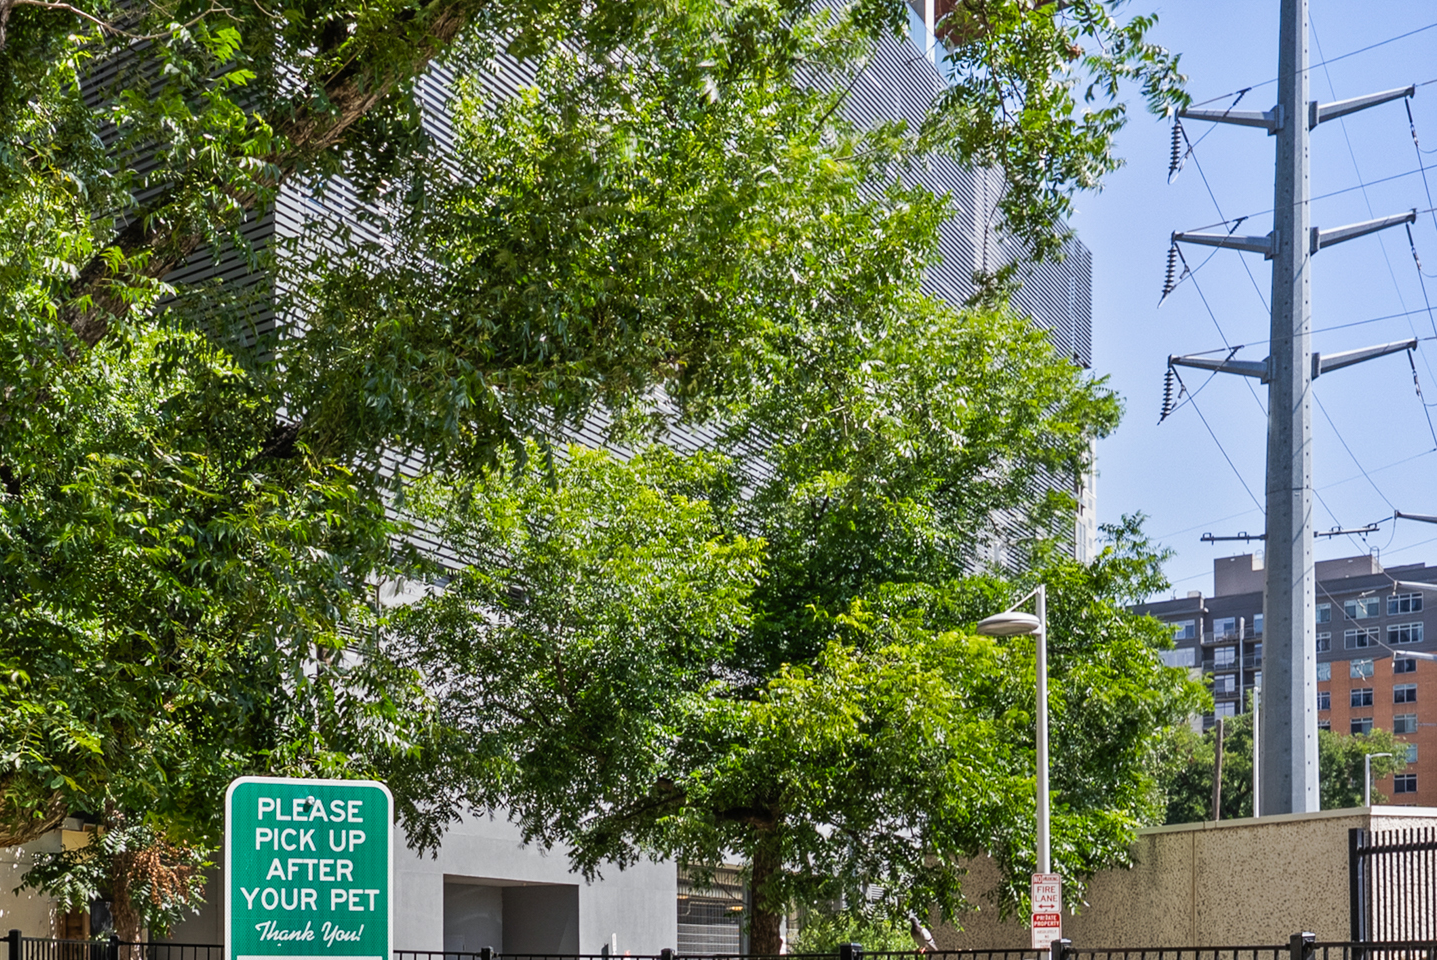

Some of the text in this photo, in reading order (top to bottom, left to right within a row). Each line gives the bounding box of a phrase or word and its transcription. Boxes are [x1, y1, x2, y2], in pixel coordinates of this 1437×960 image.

[258, 797, 363, 822] PLEASE
[255, 827, 366, 852] PICK UP
[266, 858, 354, 881] AFTER
[1034, 875, 1042, 883] NO
[240, 887, 380, 911] YOUR PET
[255, 920, 364, 948] Thank You!
